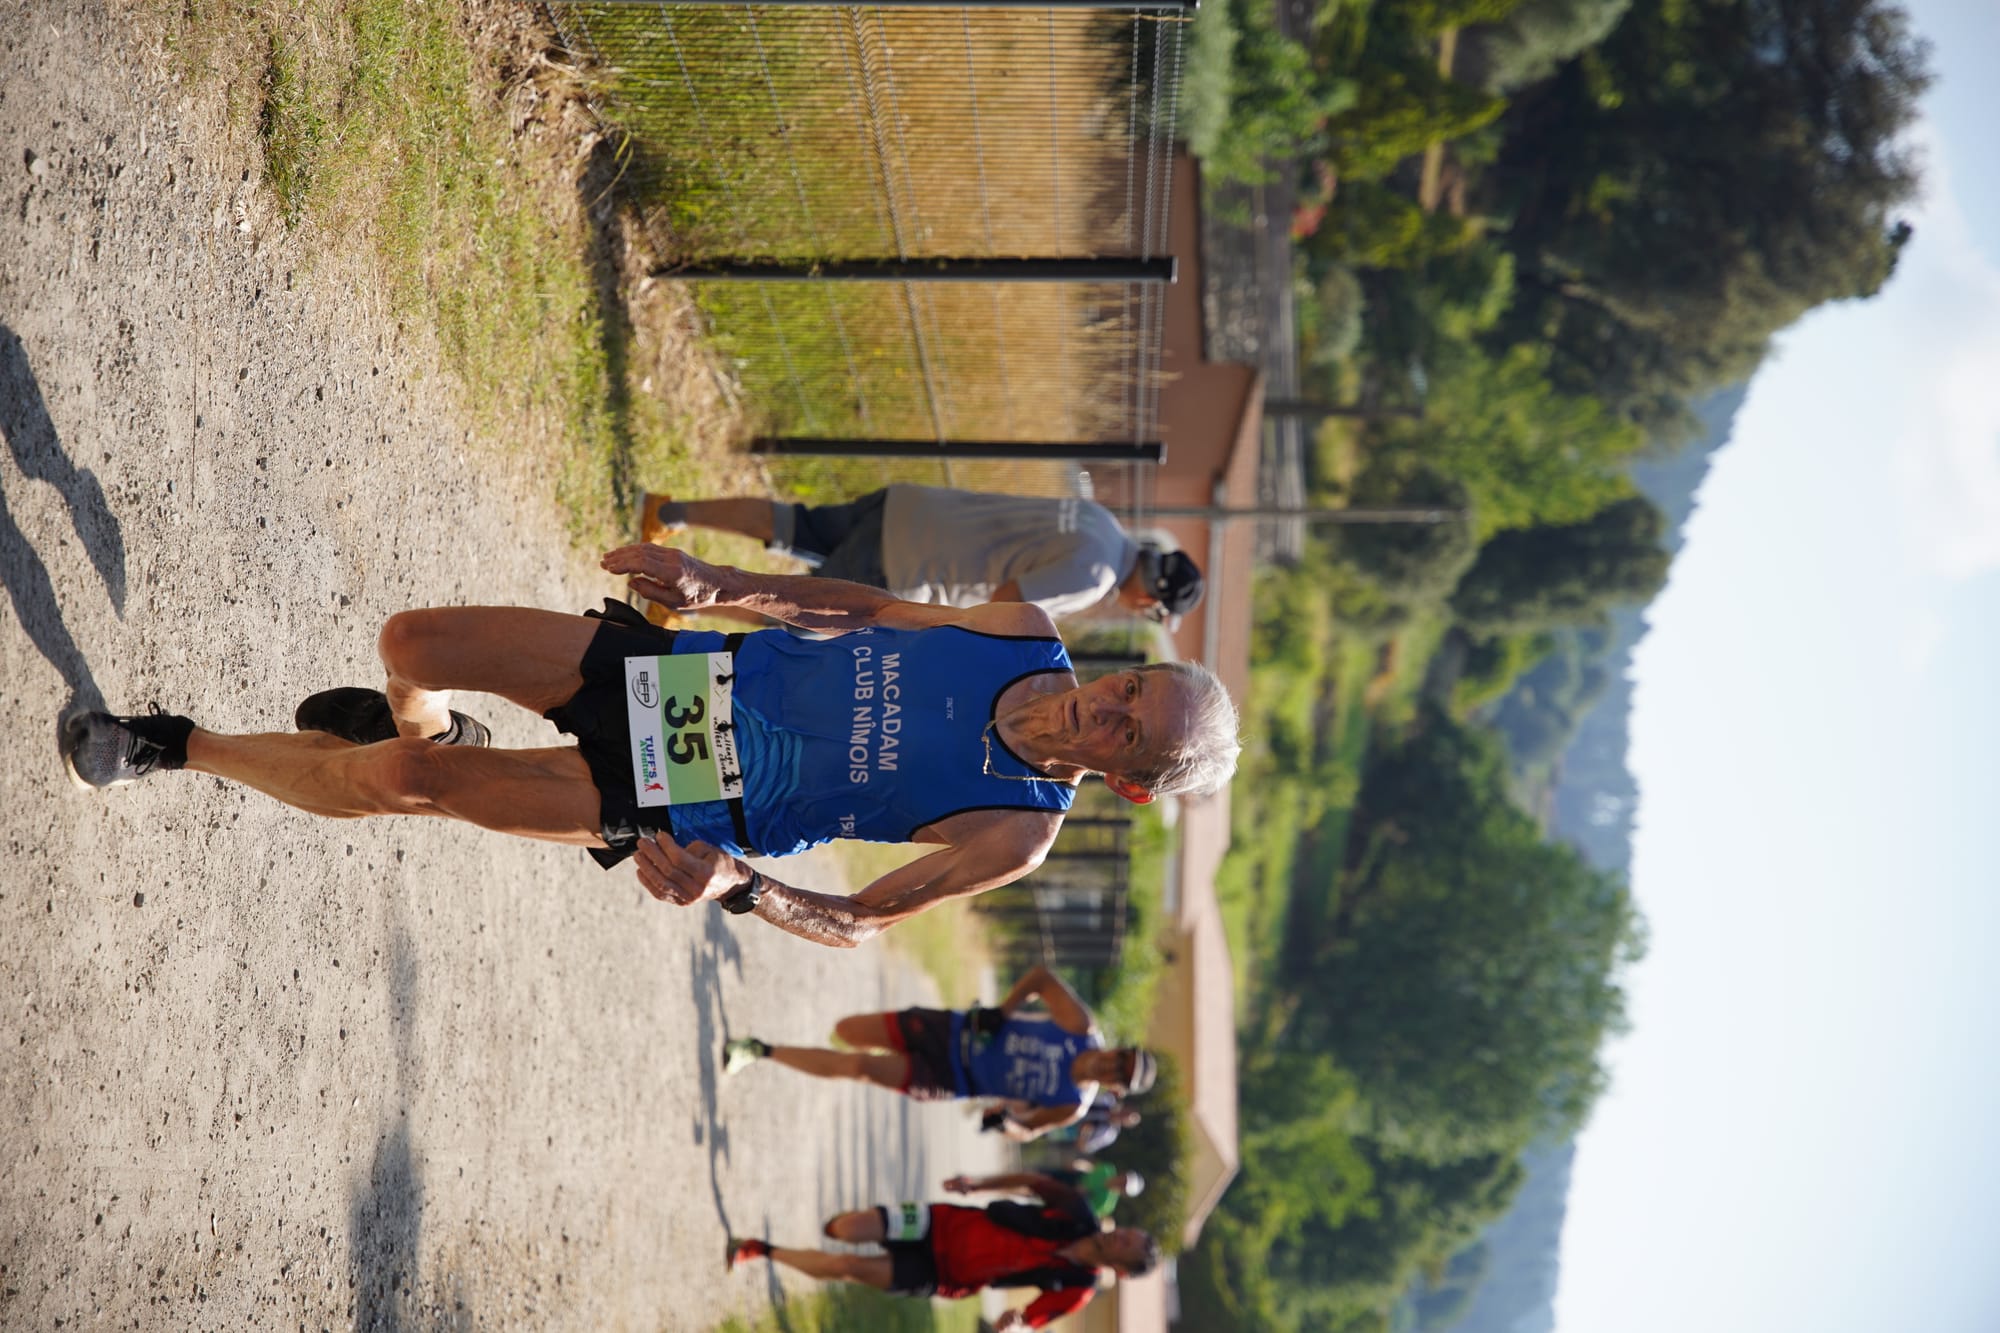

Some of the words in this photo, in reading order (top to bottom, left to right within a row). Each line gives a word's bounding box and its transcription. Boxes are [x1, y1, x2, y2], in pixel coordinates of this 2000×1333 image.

[639, 671, 650, 703] BFP
[853, 646, 874, 700] CLUB
[664, 695, 709, 765] 35
[879, 653, 901, 771] MACADAM
[639, 740, 650, 783] Aventure
[645, 736, 657, 779] TUFF'S
[849, 707, 876, 783] NÎMOIS
